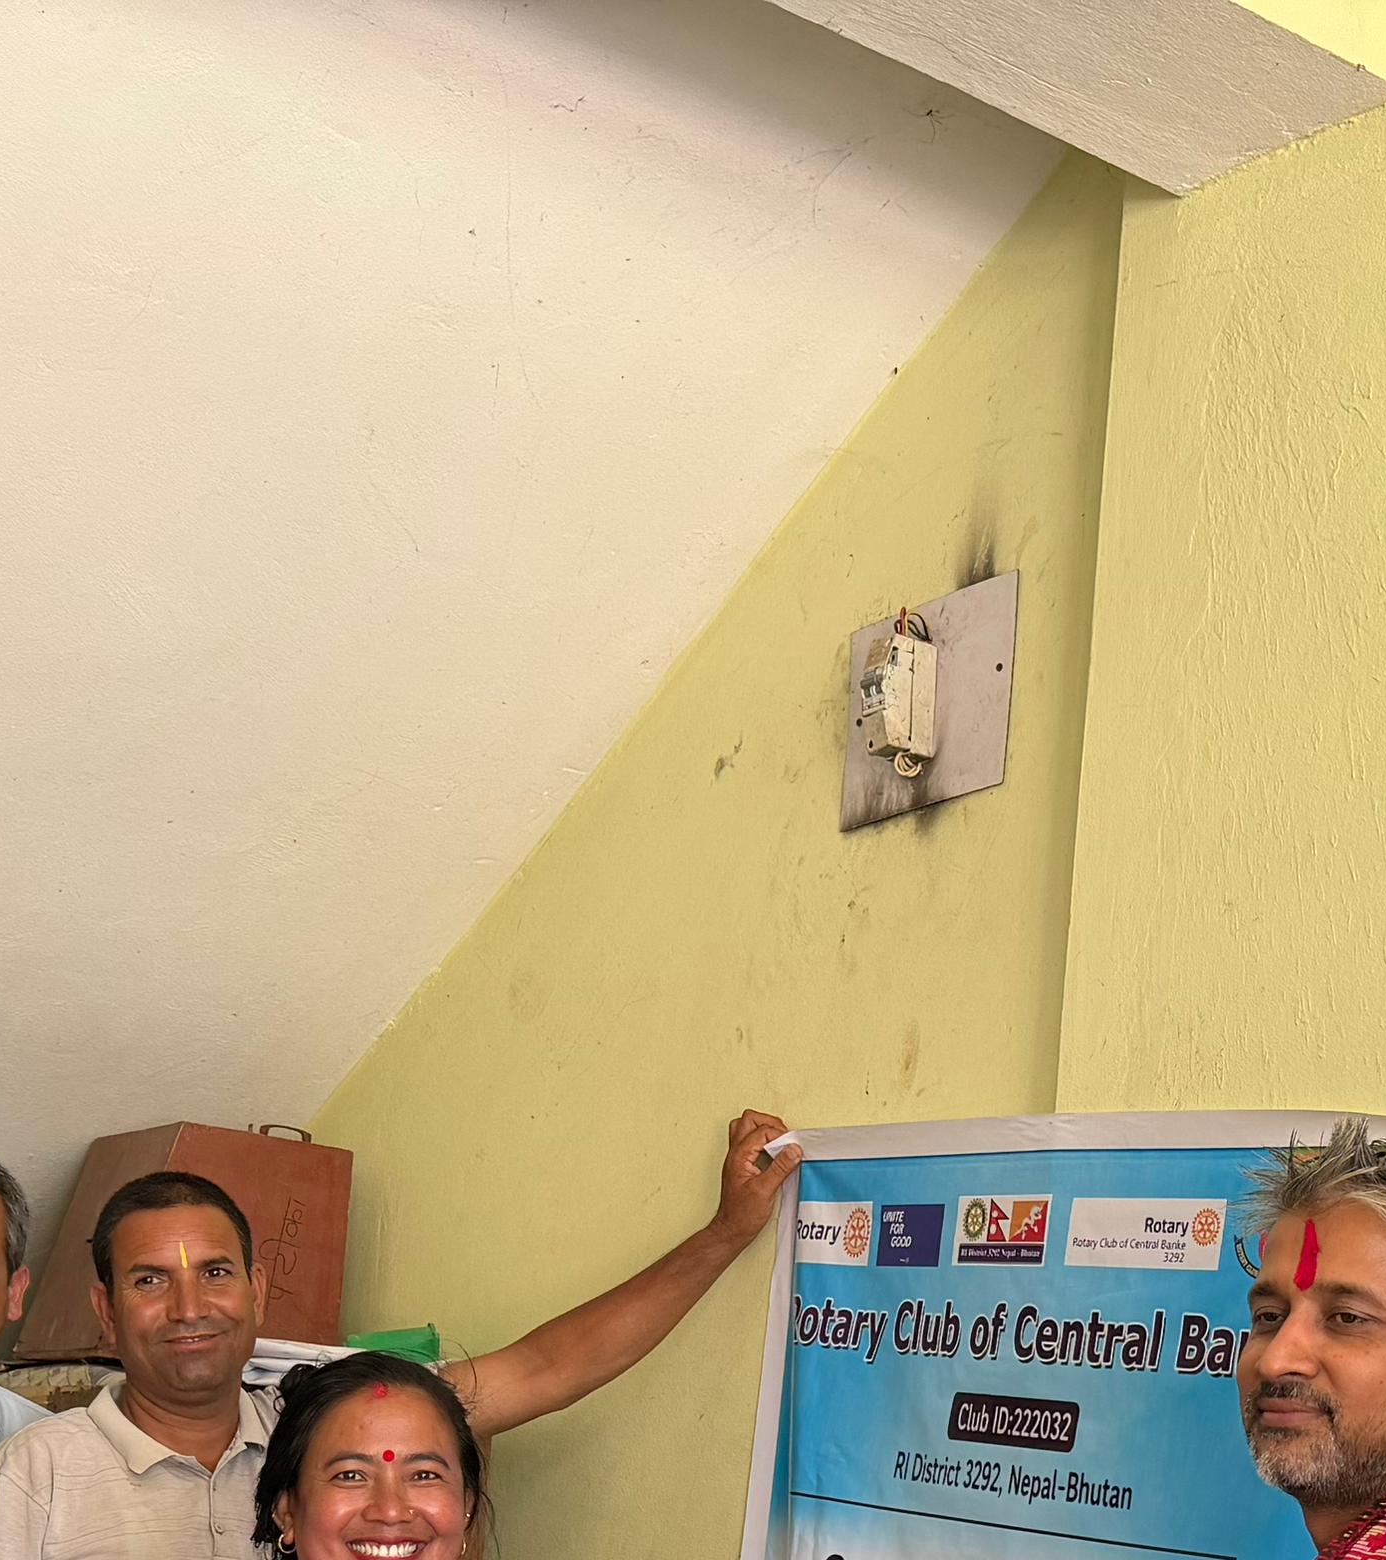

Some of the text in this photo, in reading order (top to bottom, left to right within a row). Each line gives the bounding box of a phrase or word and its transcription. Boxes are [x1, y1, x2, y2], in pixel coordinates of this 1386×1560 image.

[883, 1211, 904, 1222] UNITE
[889, 1224, 904, 1235] FOR
[1144, 1217, 1189, 1237] Rotary
[891, 1236, 912, 1248] GOOD
[1072, 1237, 1186, 1250] Rotary Club of Central Banke
[1163, 1251, 1185, 1263] 3292
[894, 1299, 961, 1357] Club
[970, 1301, 1008, 1361] of
[1014, 1304, 1165, 1371] Central
[957, 1403, 1072, 1442] Club ID:222032
[893, 1451, 1133, 1510] RI District 3292, Nepal-Bhutan
